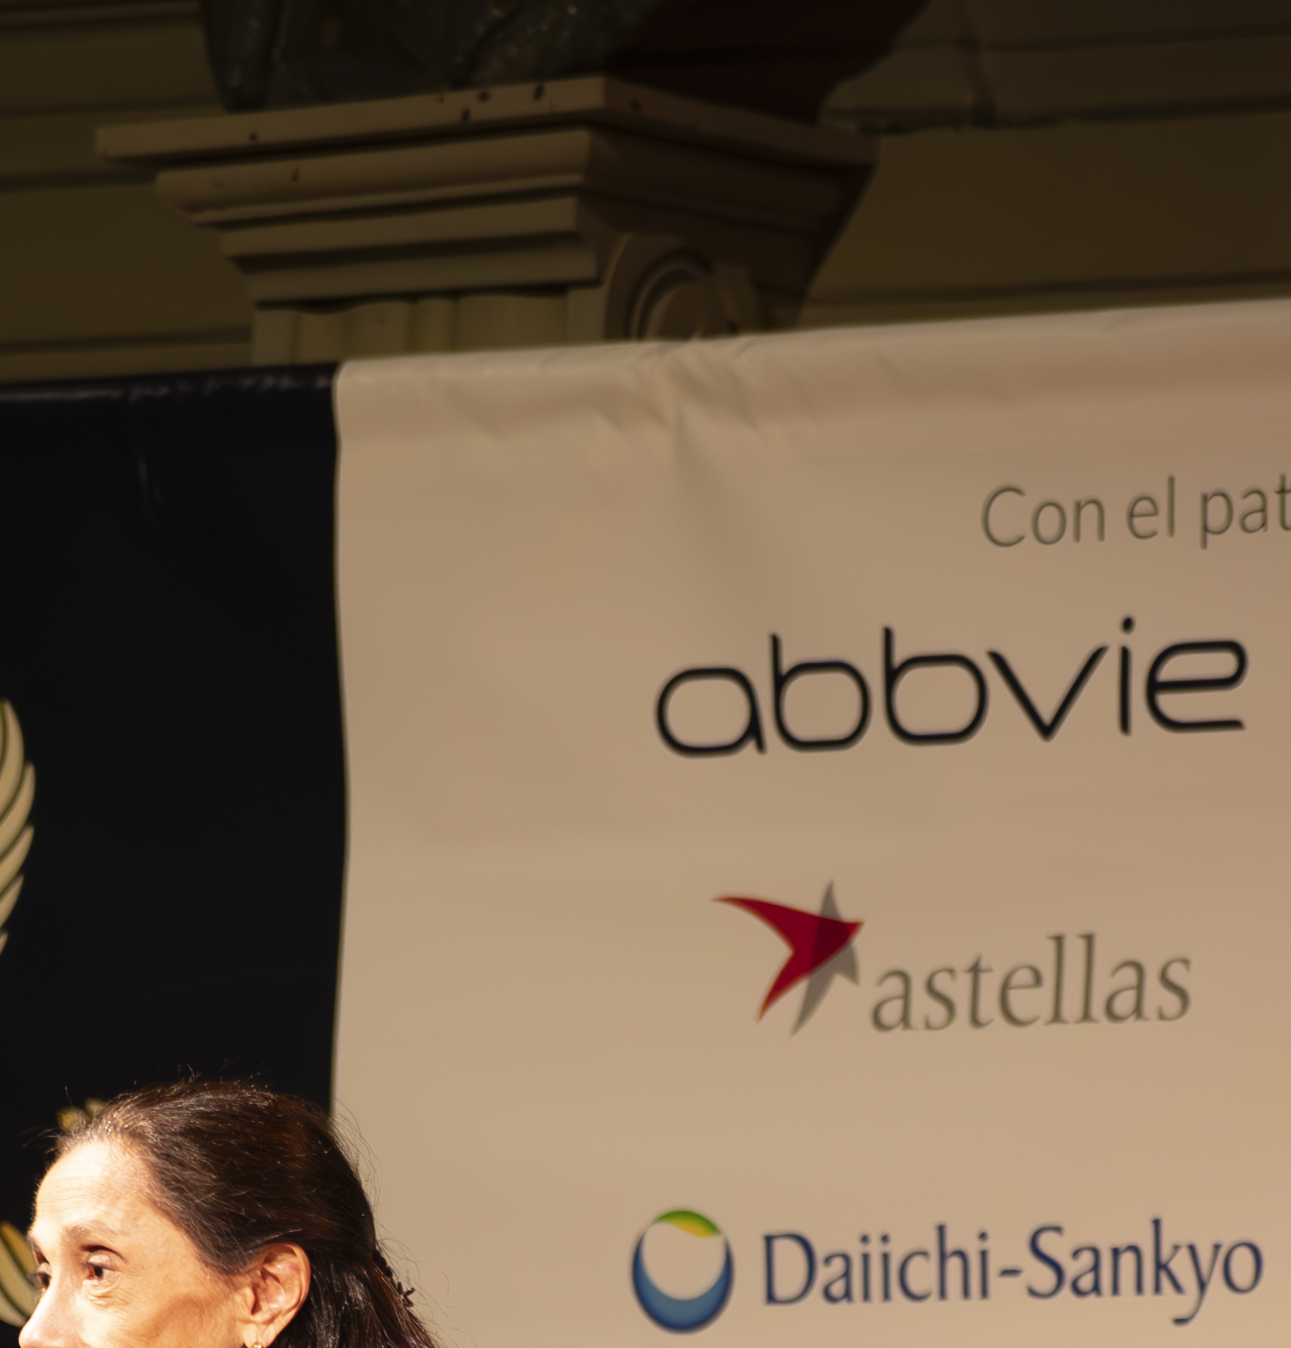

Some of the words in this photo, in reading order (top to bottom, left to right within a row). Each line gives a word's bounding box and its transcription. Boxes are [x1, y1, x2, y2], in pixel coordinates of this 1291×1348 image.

[981, 484, 1107, 548] Con
[1126, 474, 1177, 540] el
[654, 616, 1250, 761] abbvie
[869, 934, 1193, 1034] astellas
[761, 1216, 1264, 1328] Daiichi-Sankyo
